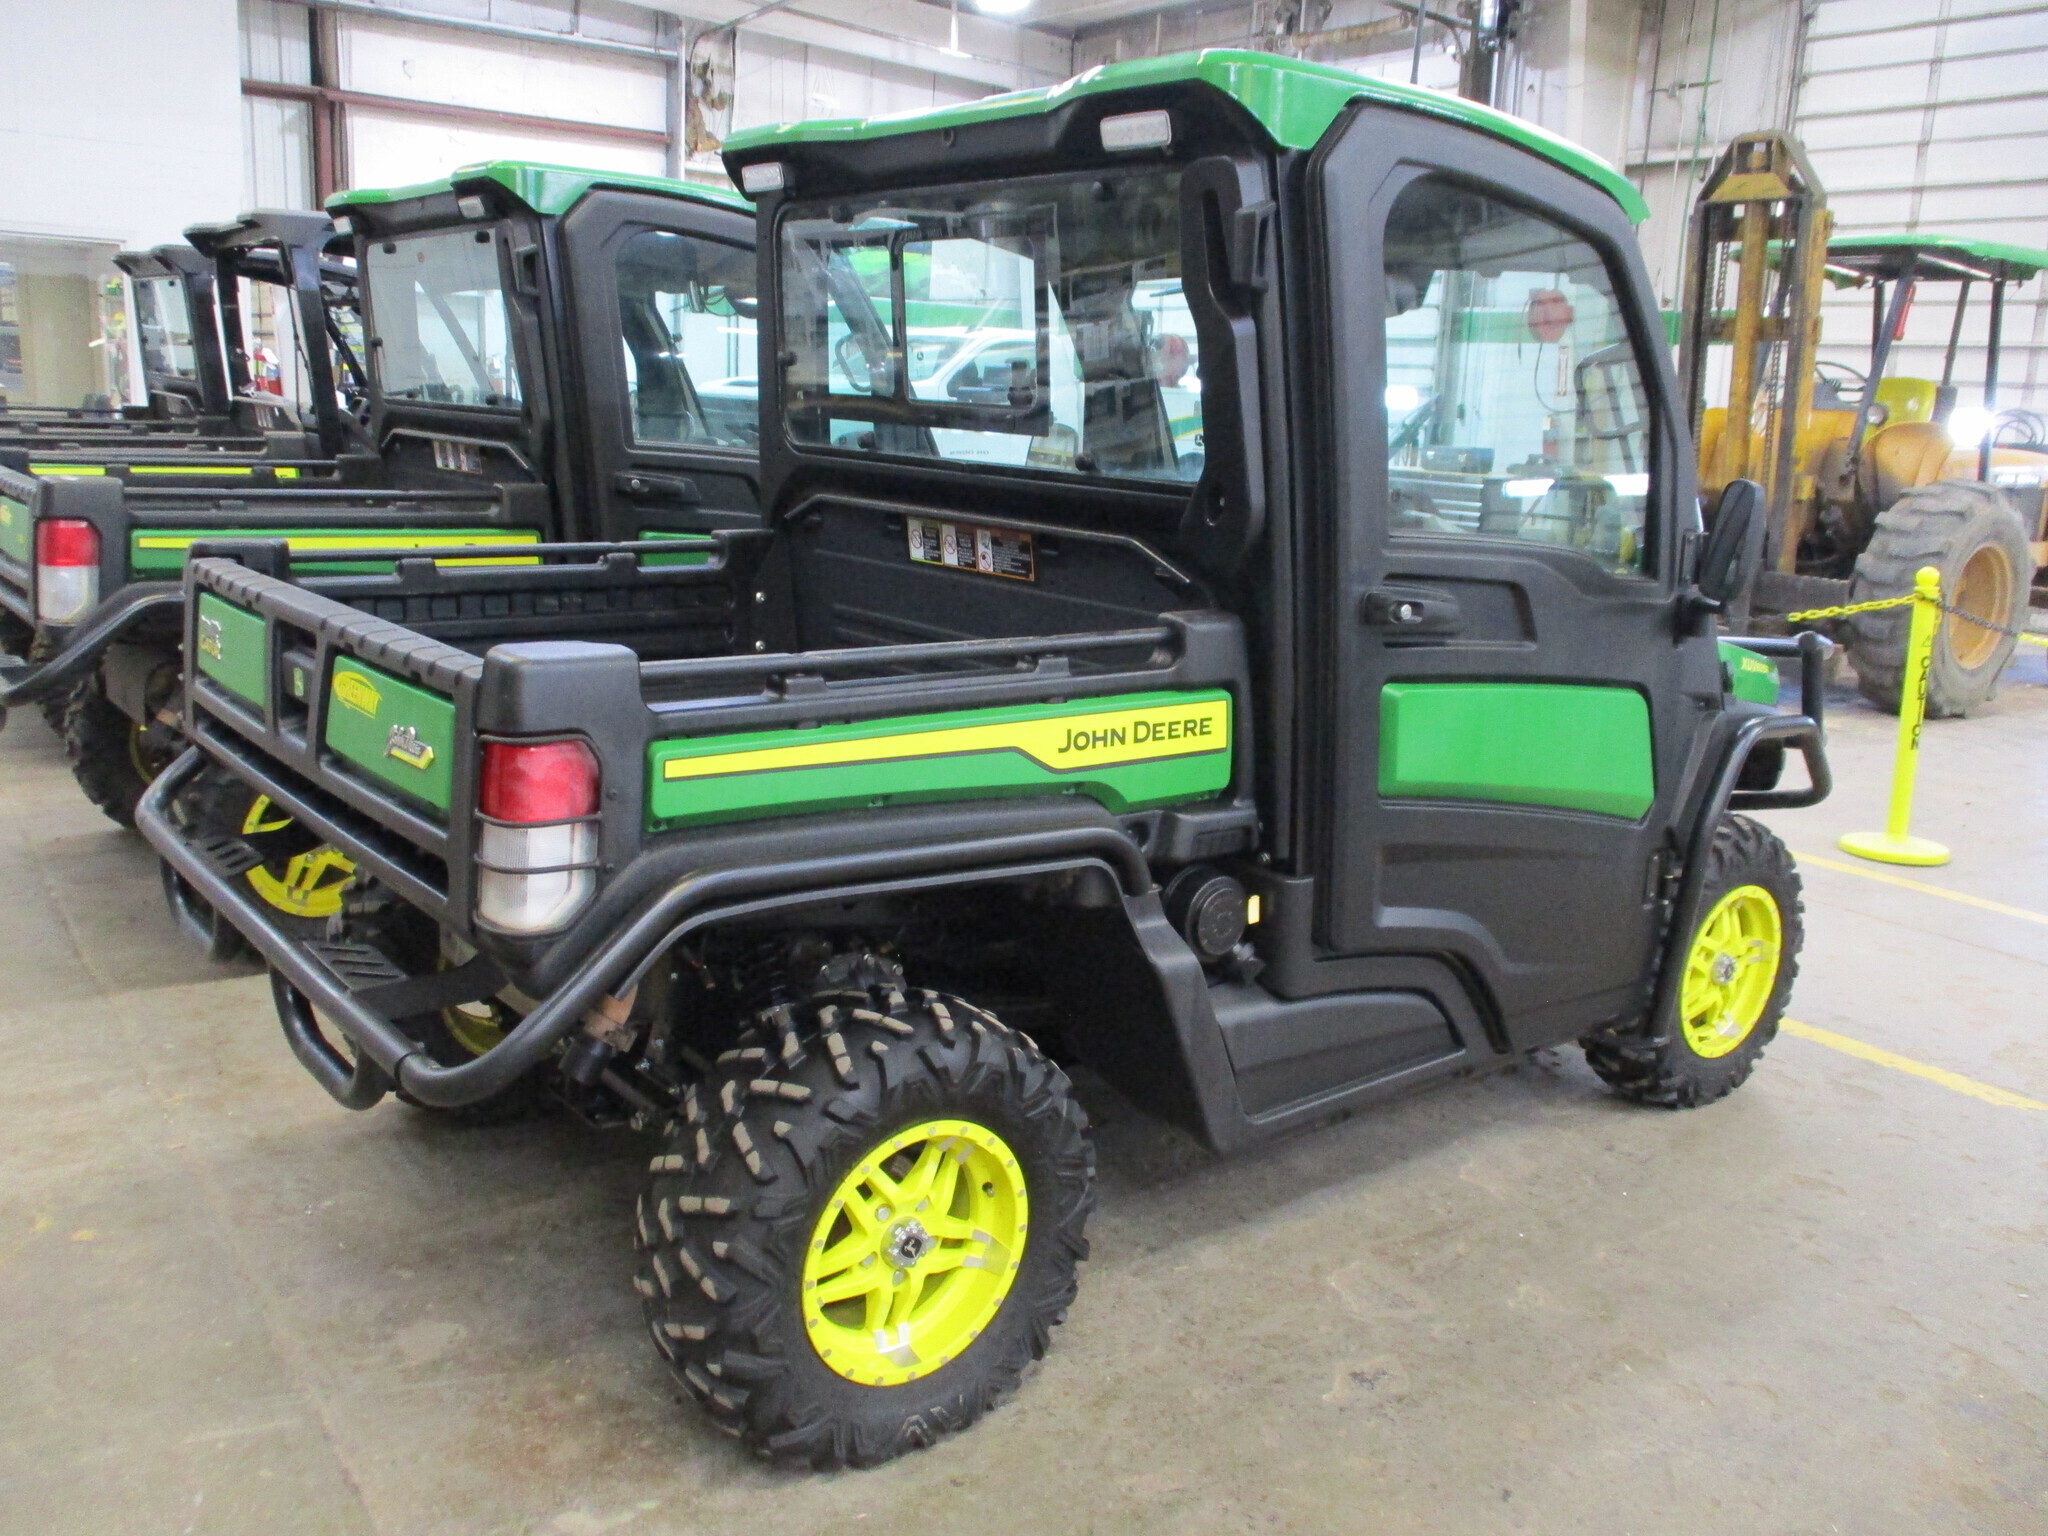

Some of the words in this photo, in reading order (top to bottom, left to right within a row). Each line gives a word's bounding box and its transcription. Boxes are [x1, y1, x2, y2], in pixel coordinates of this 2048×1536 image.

[1058, 727, 1127, 754] JOHN
[1133, 717, 1213, 744] DEERE
[1910, 655, 1931, 750] CAUTION
